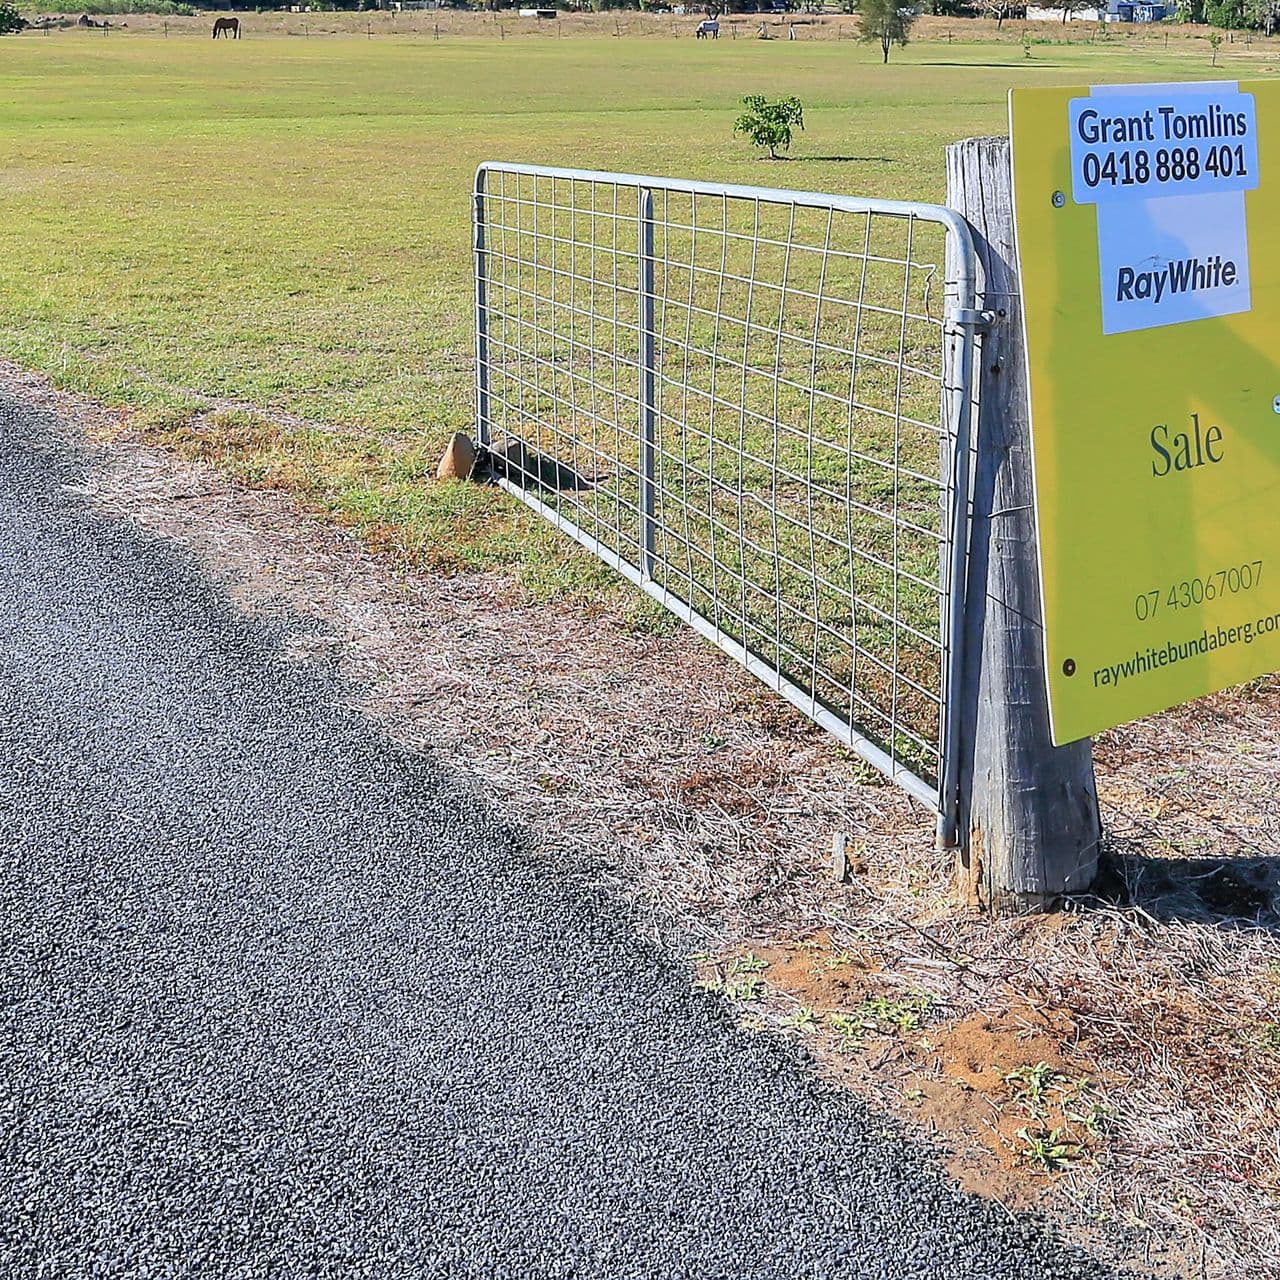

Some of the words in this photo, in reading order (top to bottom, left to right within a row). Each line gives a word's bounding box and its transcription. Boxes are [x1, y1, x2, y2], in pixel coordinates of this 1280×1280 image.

[1078, 109, 1154, 144] Grant
[1158, 104, 1247, 141] Tomlins
[1082, 149, 1150, 188] 0418
[1155, 146, 1200, 182] 888
[1205, 144, 1247, 178] 401
[1150, 413, 1224, 477] Sale
[1135, 590, 1159, 621] 07
[1166, 560, 1263, 611] 43067007
